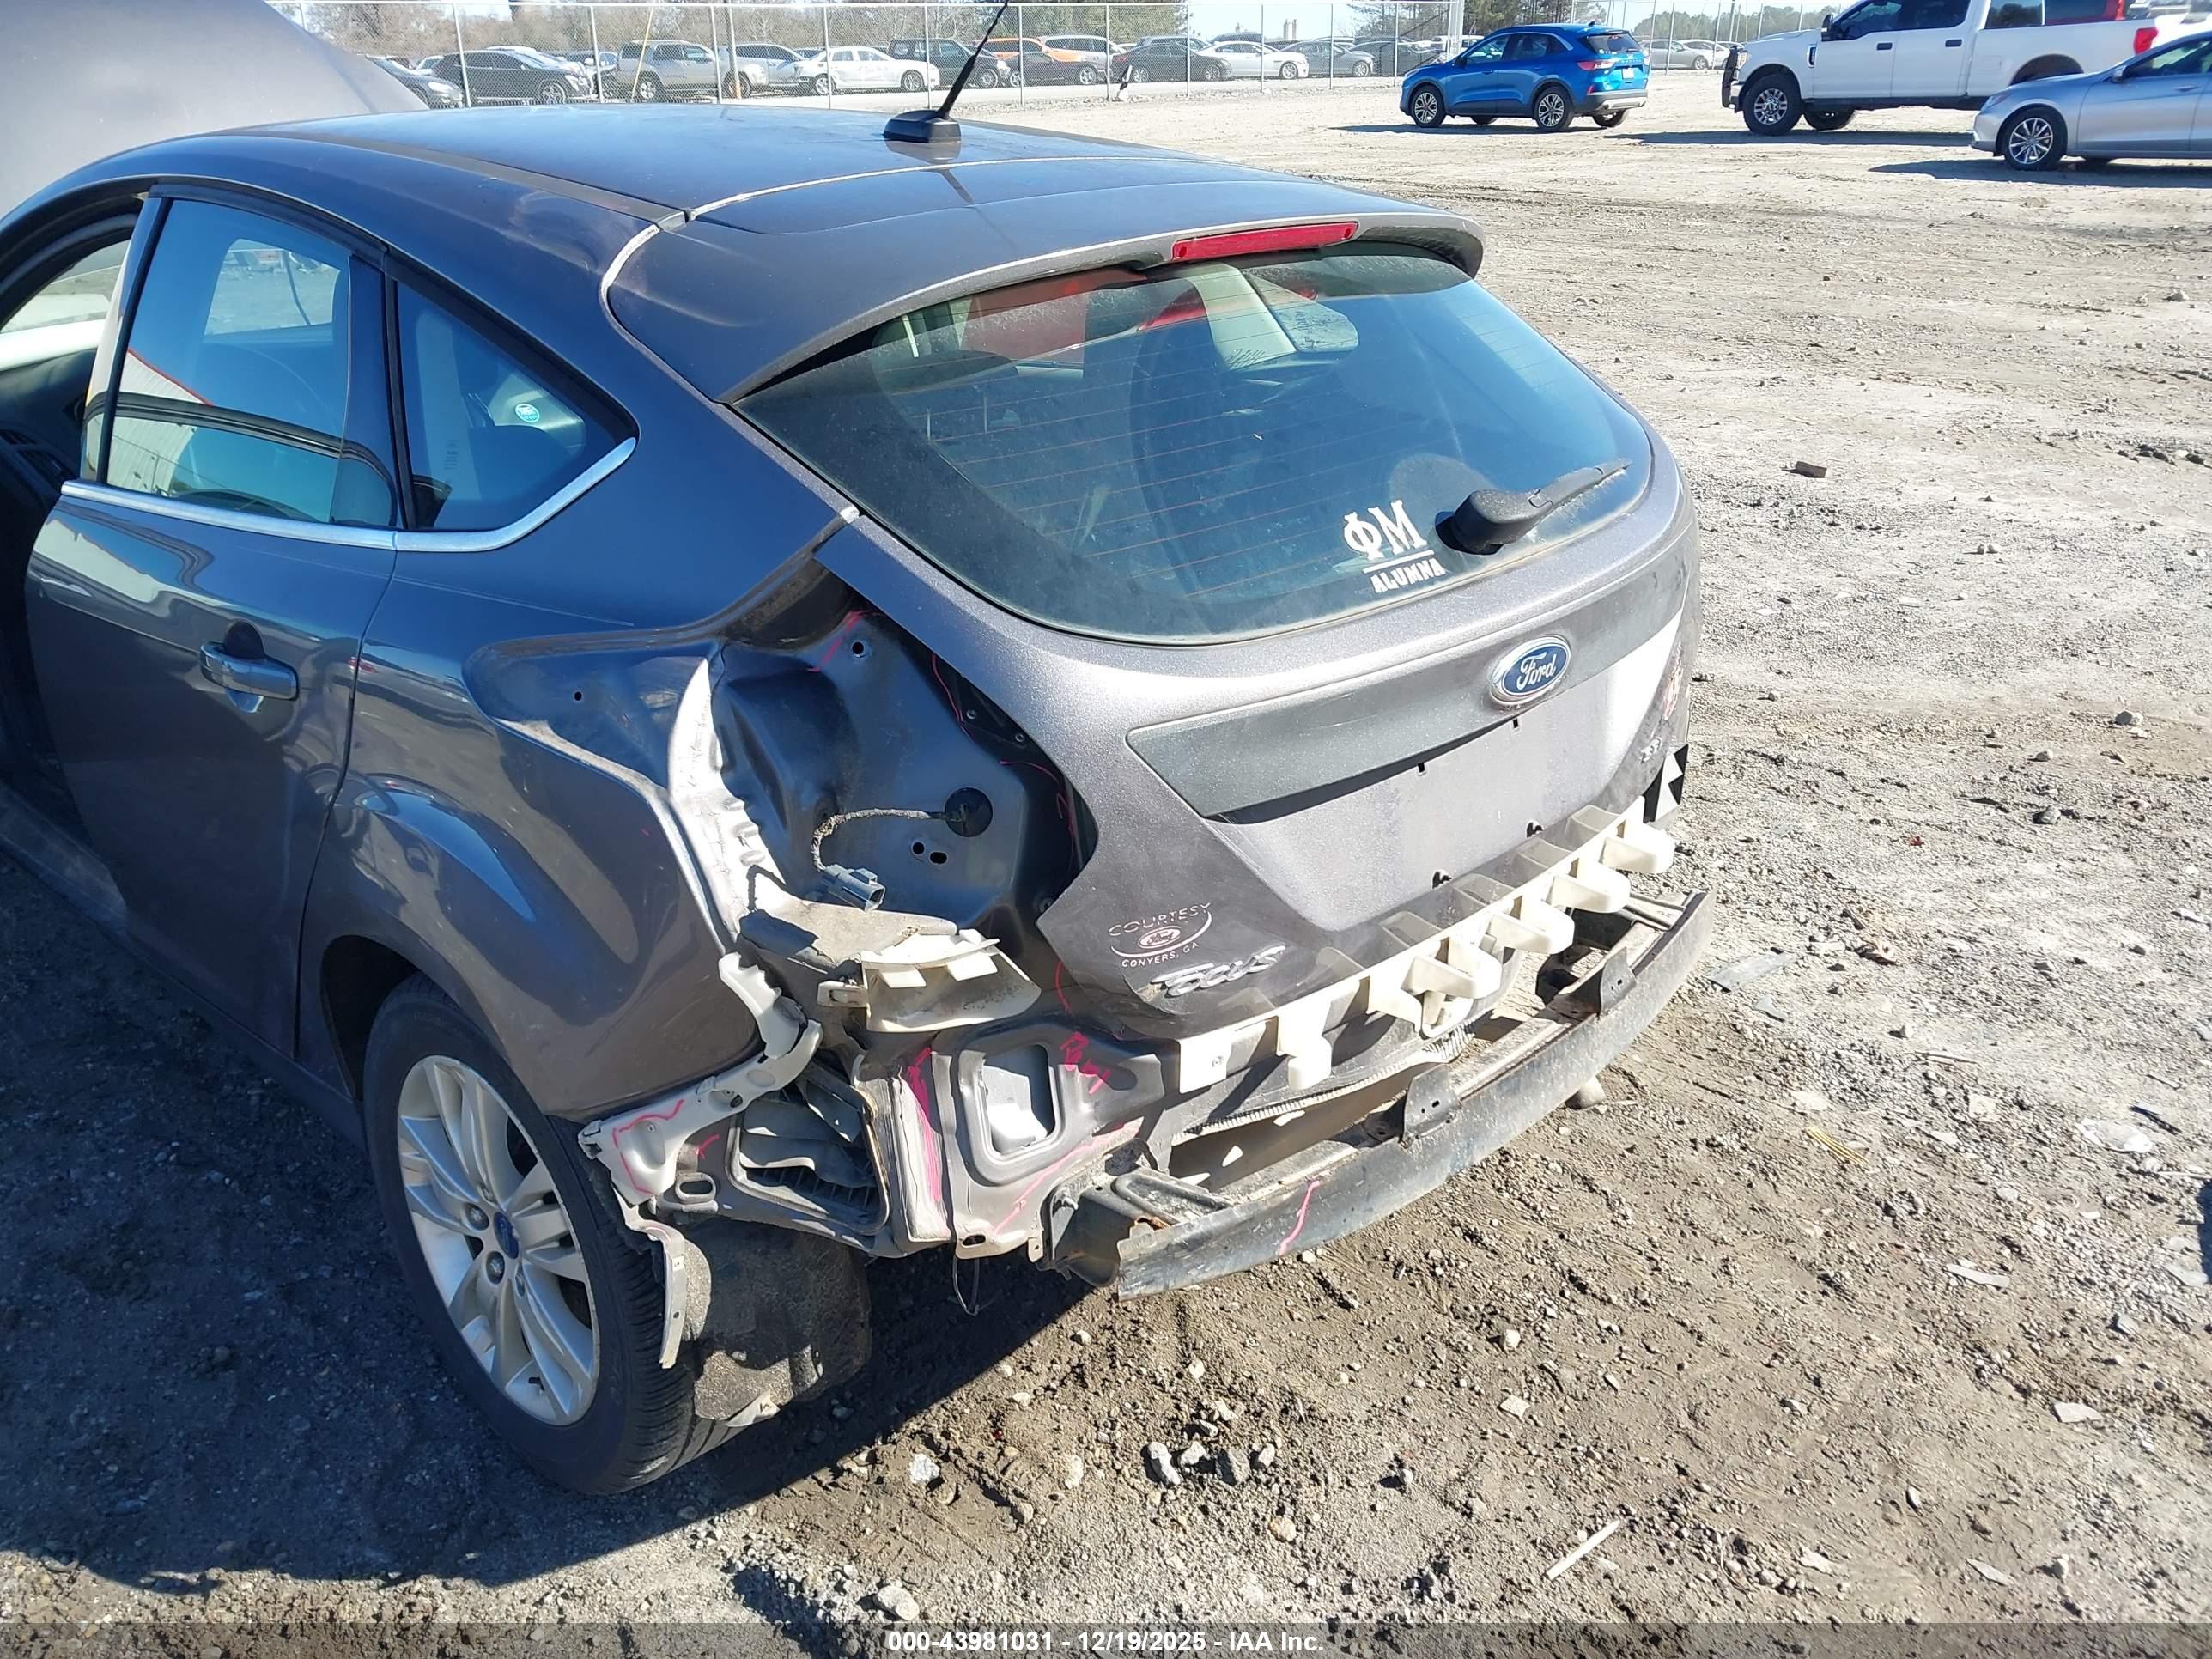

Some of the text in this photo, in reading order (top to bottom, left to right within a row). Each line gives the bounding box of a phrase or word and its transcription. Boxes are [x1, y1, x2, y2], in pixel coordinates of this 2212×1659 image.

[1370, 558, 1447, 593] ALUMNA
[1516, 652, 1558, 690] Ford
[1109, 902, 1212, 937] COURTESY
[1121, 941, 1200, 968] CONYERS, GA
